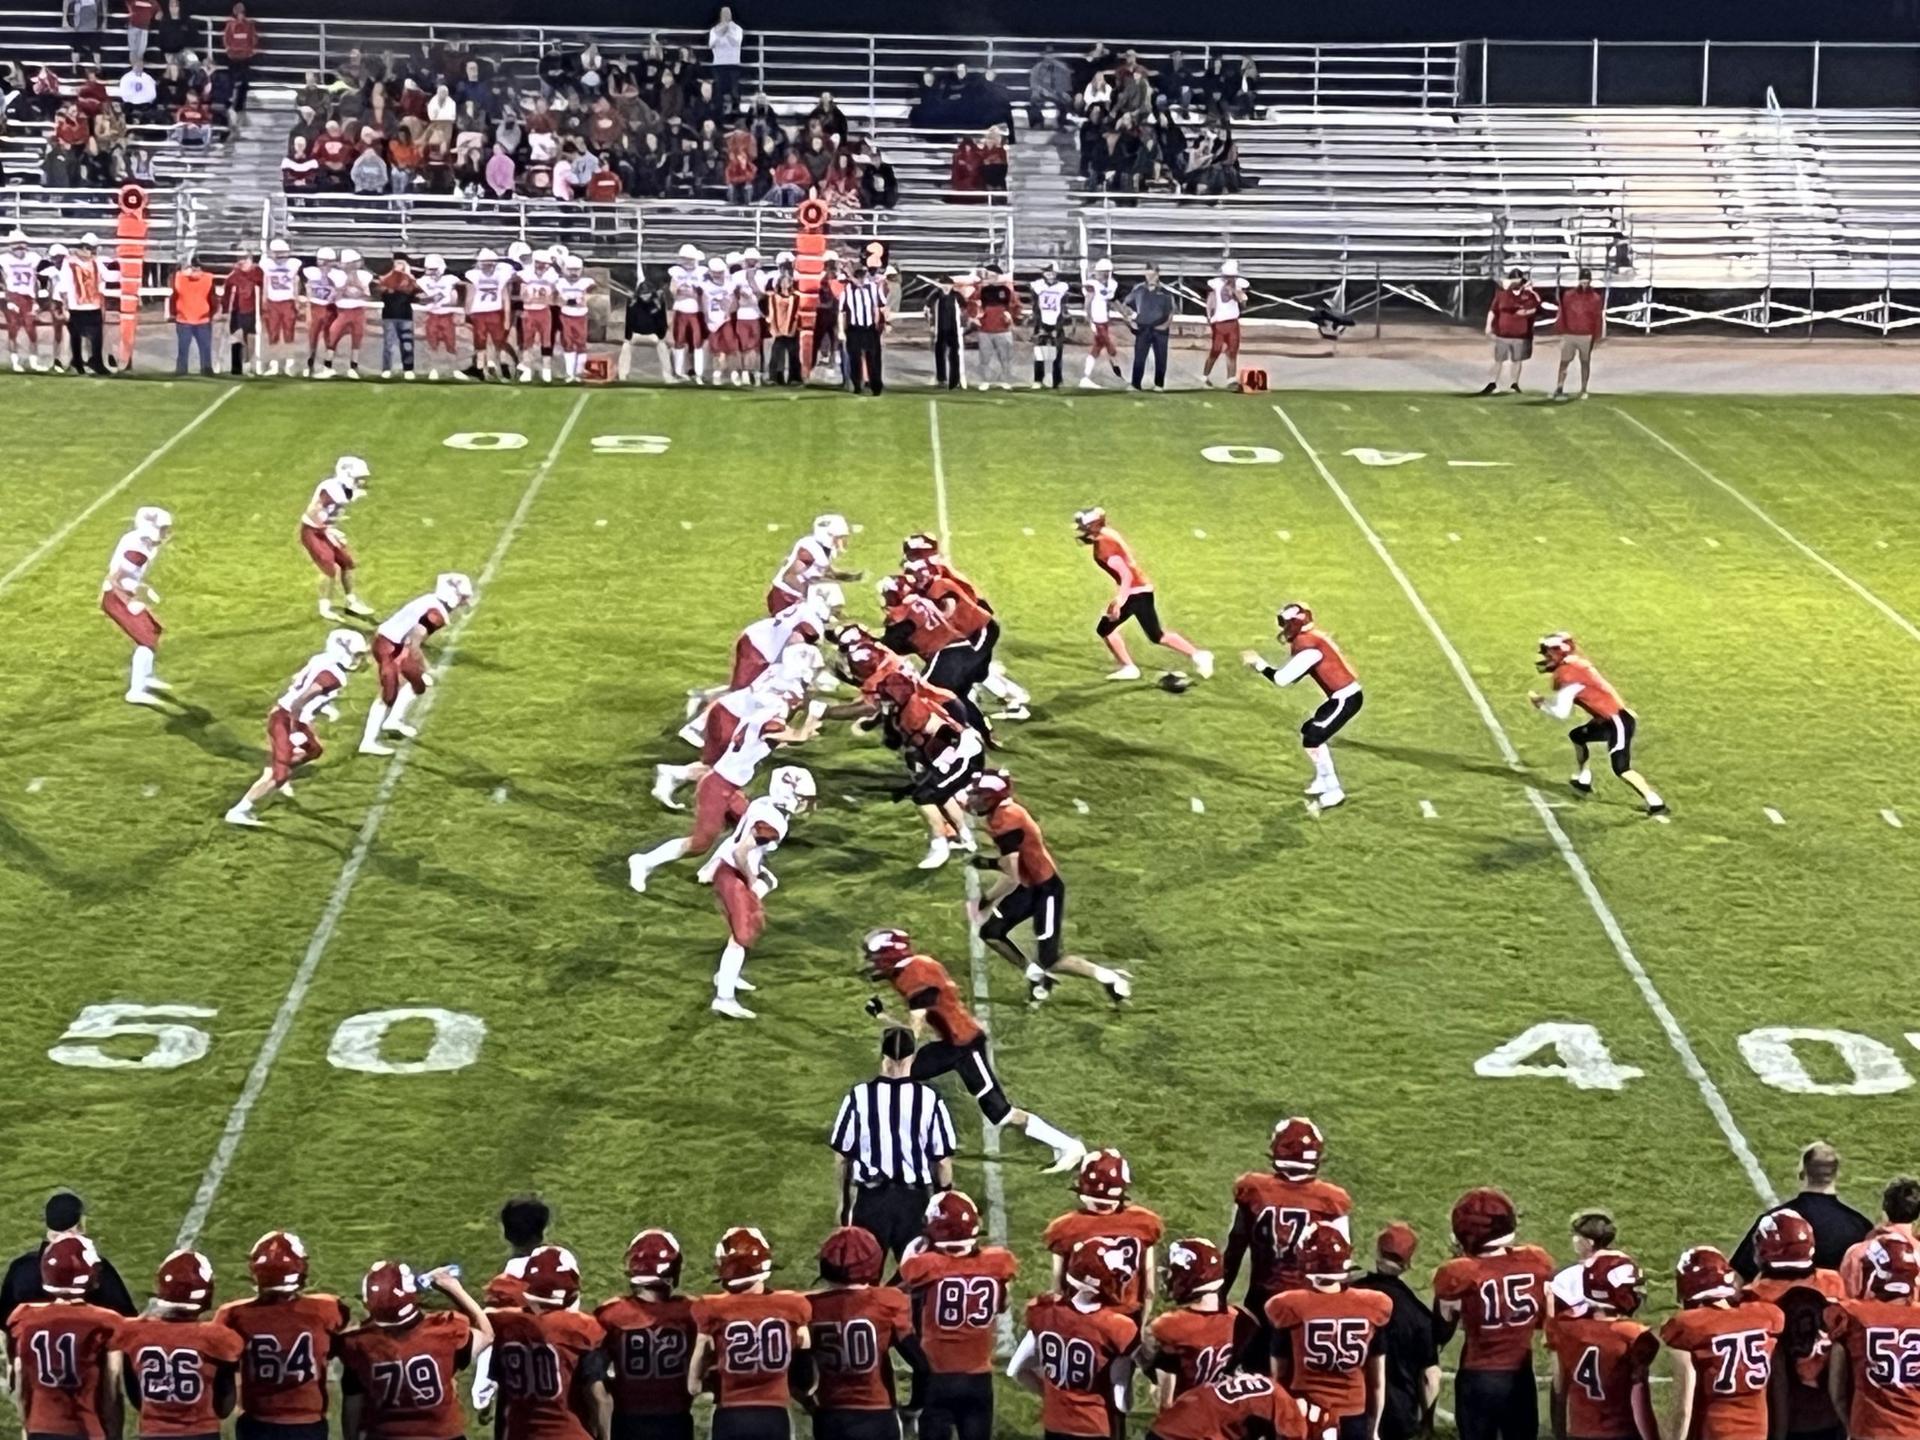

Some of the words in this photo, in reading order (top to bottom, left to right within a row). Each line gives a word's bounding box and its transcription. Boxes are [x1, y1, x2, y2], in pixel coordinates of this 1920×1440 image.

[1253, 1206, 1310, 1259] 17
[935, 1276, 999, 1329] 83
[1480, 1273, 1539, 1329] 15
[30, 1330, 82, 1387] 11
[248, 1331, 317, 1386] 64
[621, 1327, 688, 1379] 82
[724, 1318, 792, 1373] 20
[816, 1318, 877, 1374] 50
[1304, 1318, 1370, 1372] 55
[1711, 1329, 1771, 1393] 75
[1866, 1327, 1920, 1388] 52
[139, 1345, 204, 1404] 26
[371, 1354, 444, 1407] 79
[1573, 1346, 1605, 1401] 4
